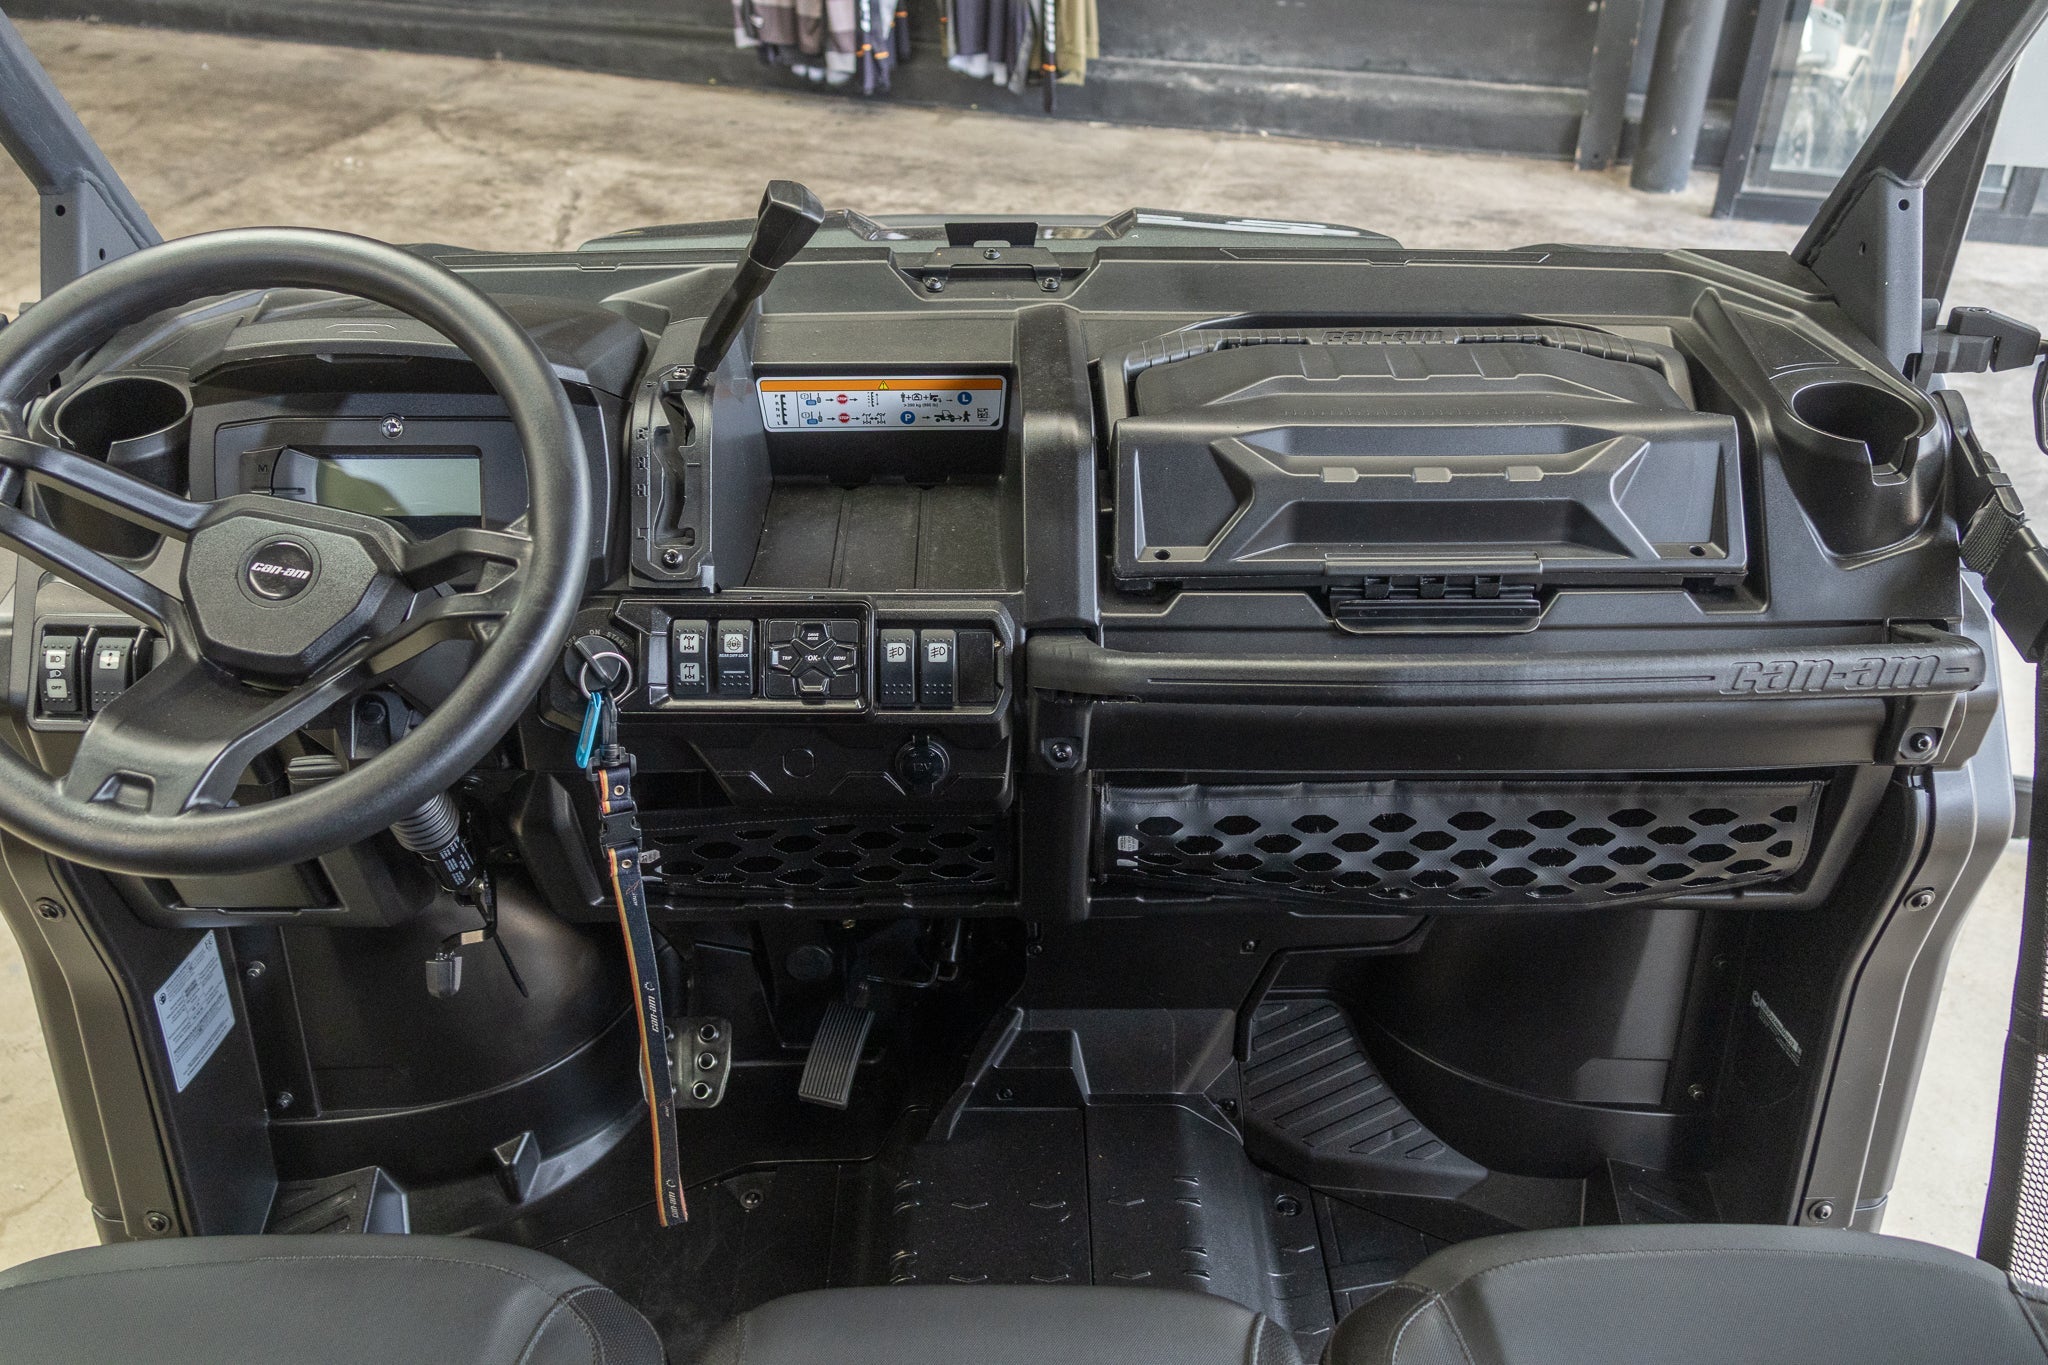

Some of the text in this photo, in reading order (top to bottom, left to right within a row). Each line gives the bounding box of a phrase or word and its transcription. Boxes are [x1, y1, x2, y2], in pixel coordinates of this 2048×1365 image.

[258, 464, 268, 473] M
[251, 562, 311, 580] can-am
[606, 631, 628, 649] START
[1719, 655, 1941, 694] can-am
[648, 995, 659, 1033] can-am
